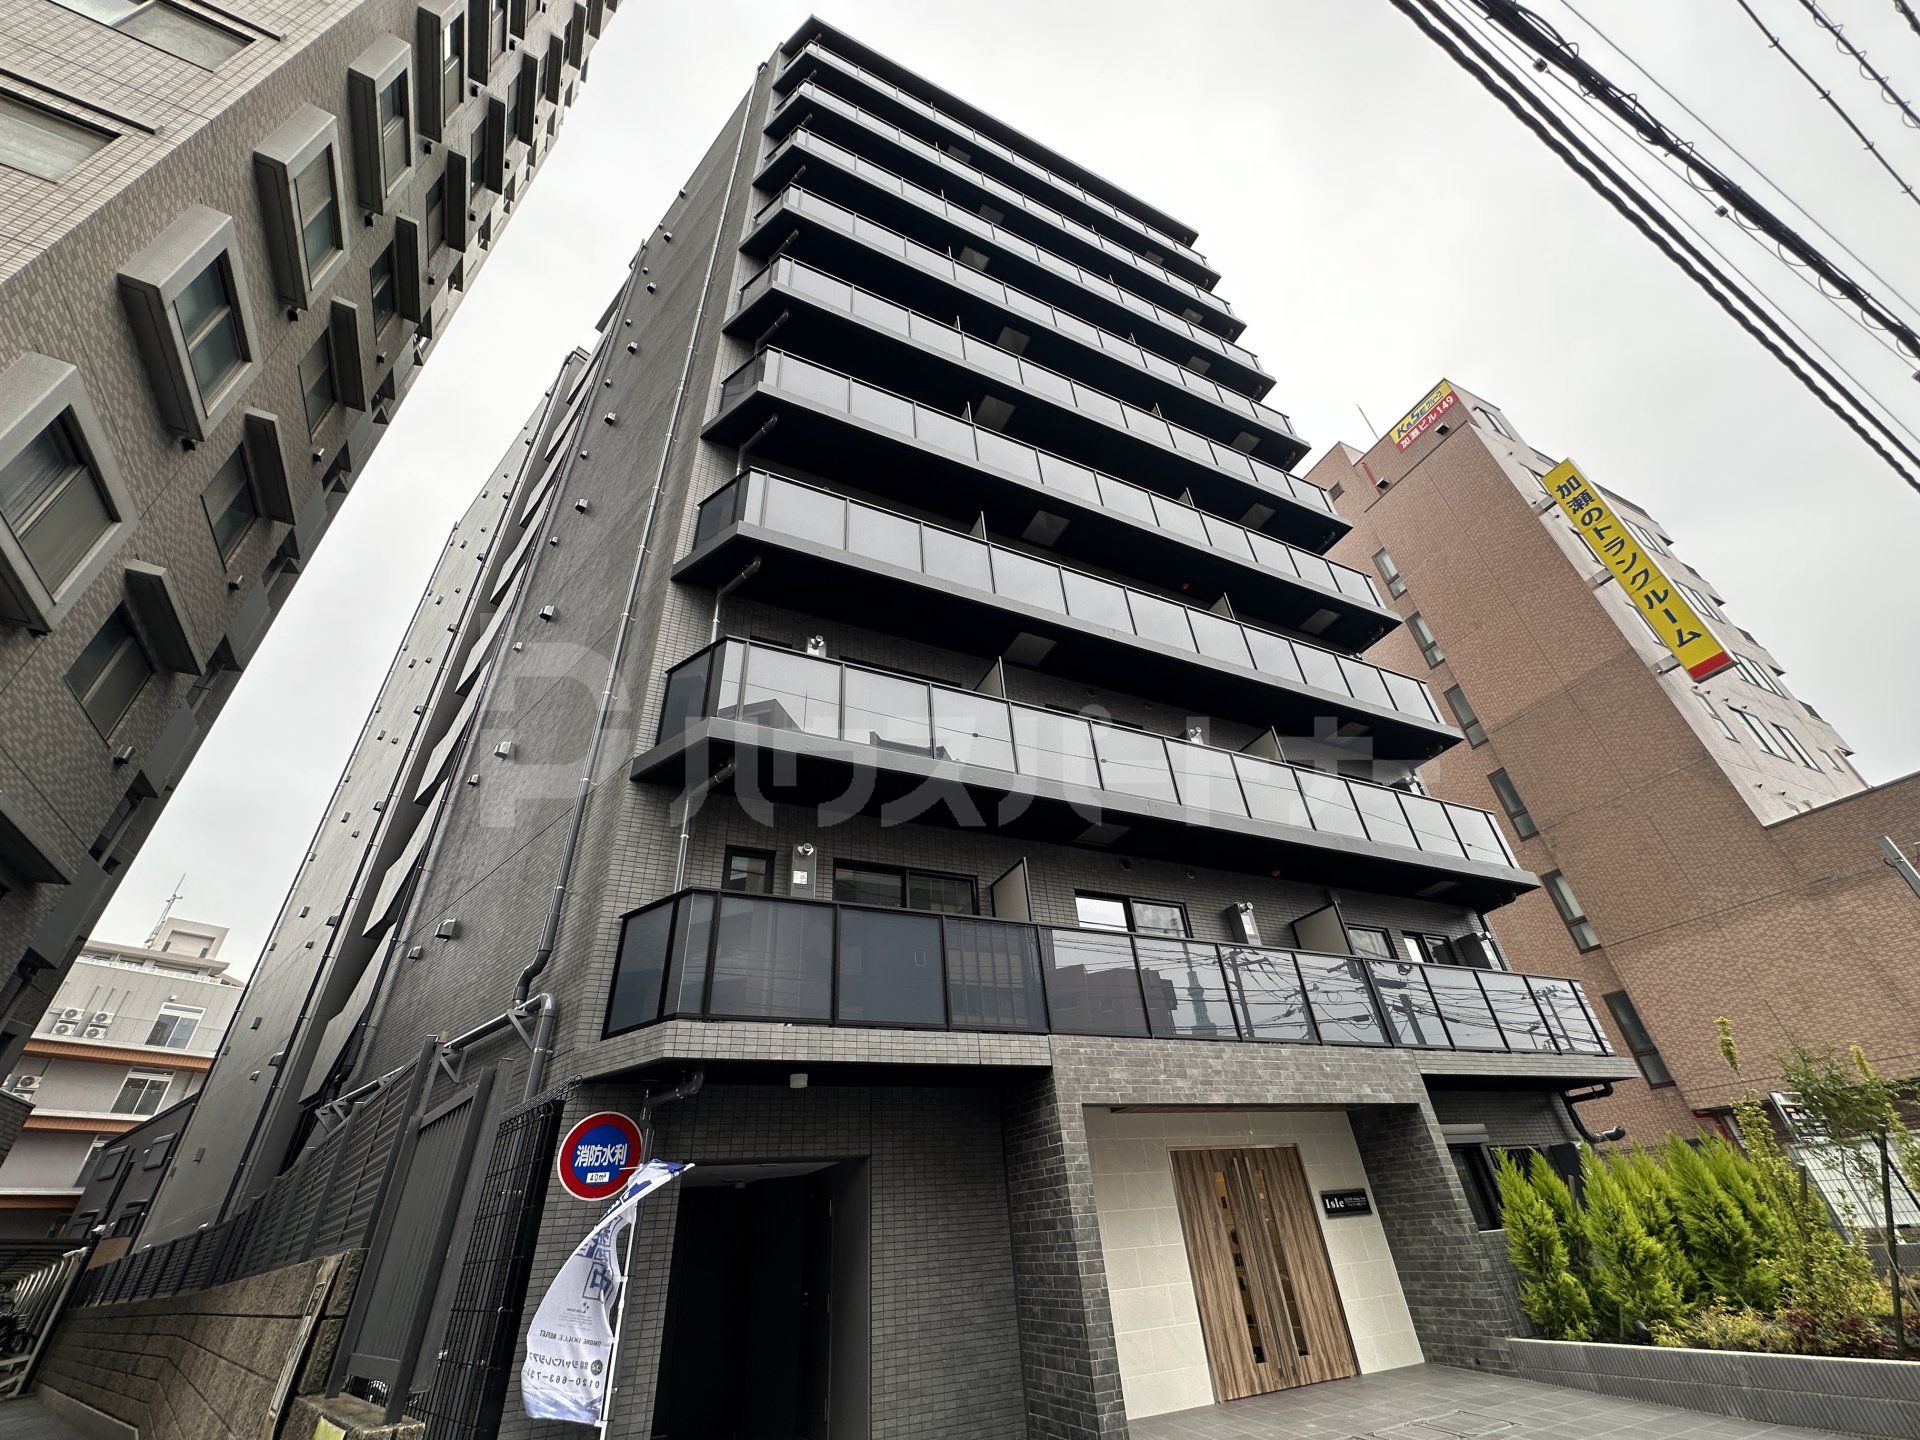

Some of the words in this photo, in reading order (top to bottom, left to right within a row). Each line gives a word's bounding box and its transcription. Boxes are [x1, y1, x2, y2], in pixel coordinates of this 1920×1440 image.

[1555, 474, 1702, 648] 加瀬のトランクルーム
[574, 1142, 628, 1168] 消防水利
[1325, 1197, 1345, 1209] Isle
